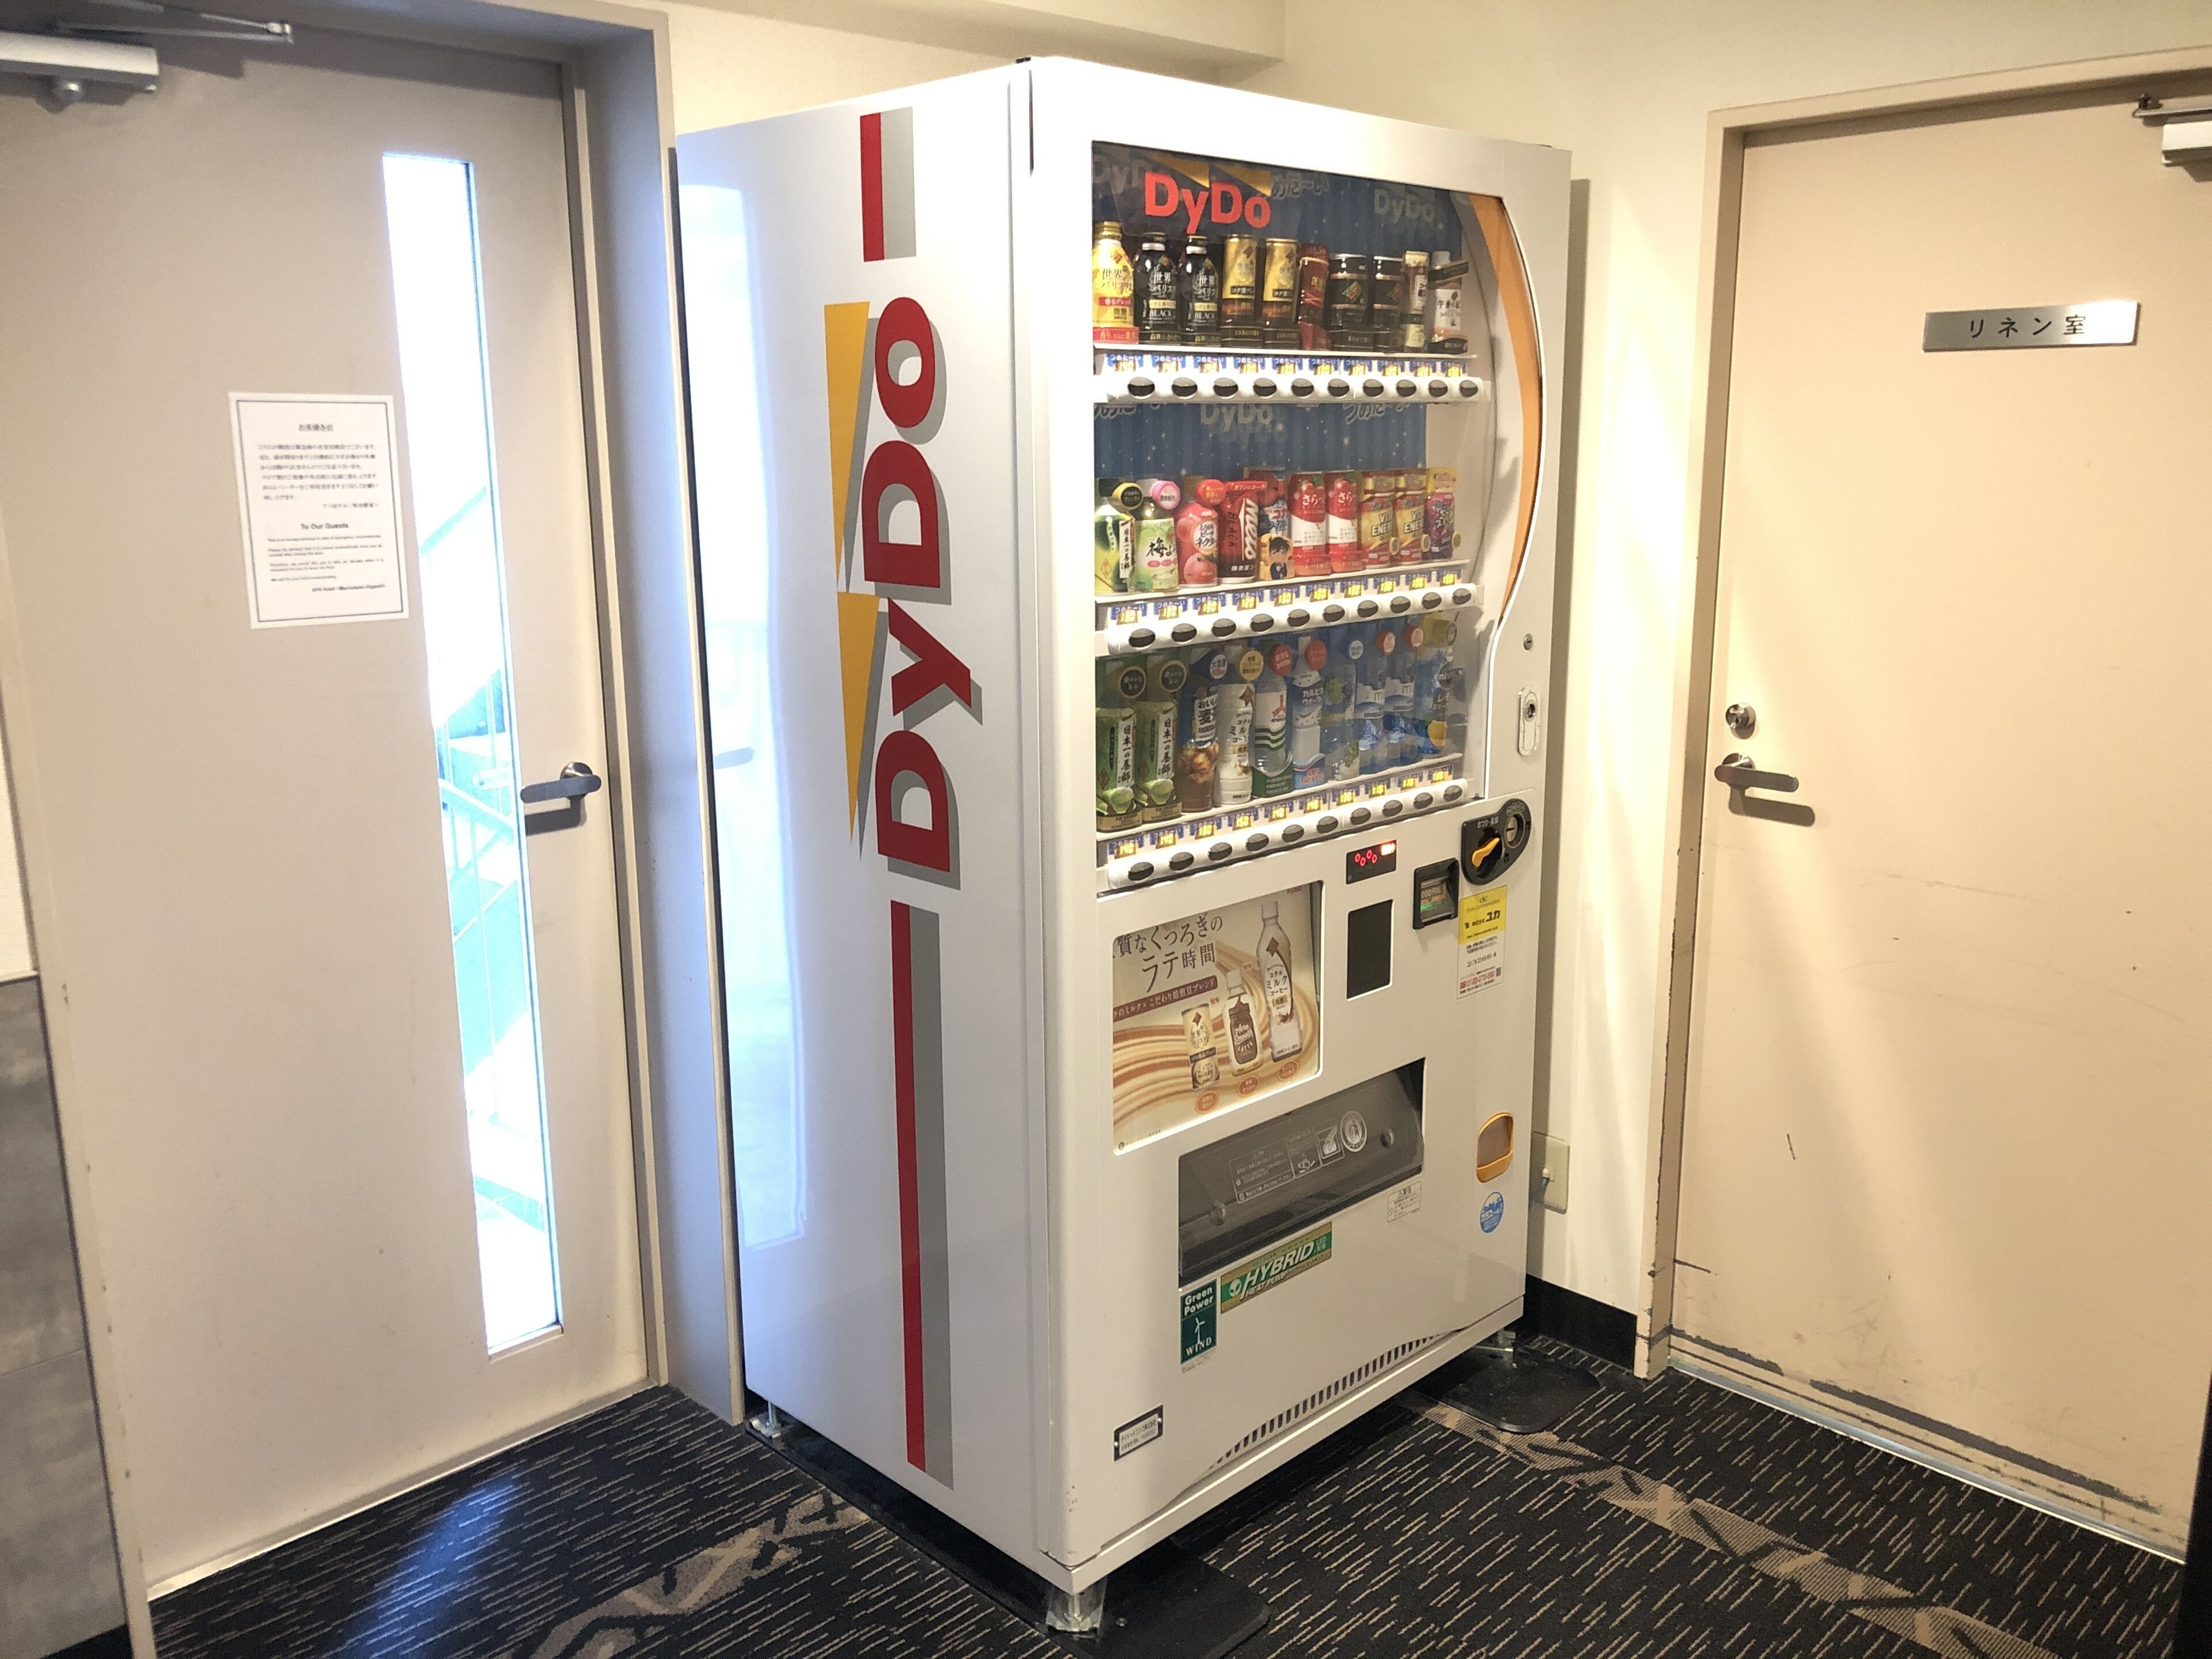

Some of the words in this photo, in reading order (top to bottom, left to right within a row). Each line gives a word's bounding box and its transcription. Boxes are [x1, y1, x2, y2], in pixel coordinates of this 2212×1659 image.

[1145, 171, 1271, 234] DyDo
[1969, 315, 2086, 338] リネン室
[862, 297, 974, 876] DyDo
[1113, 913, 1222, 959] 質なくつろぎの
[1142, 942, 1215, 993] ラテ時間
[1240, 1241, 1315, 1301] HYBRID
[1246, 1283, 1267, 1297] HEAT
[1267, 1271, 1288, 1286] PUMP
[1184, 1286, 1213, 1306] Green
[1184, 1296, 1214, 1317] Power
[1185, 1336, 1212, 1356] WIND
